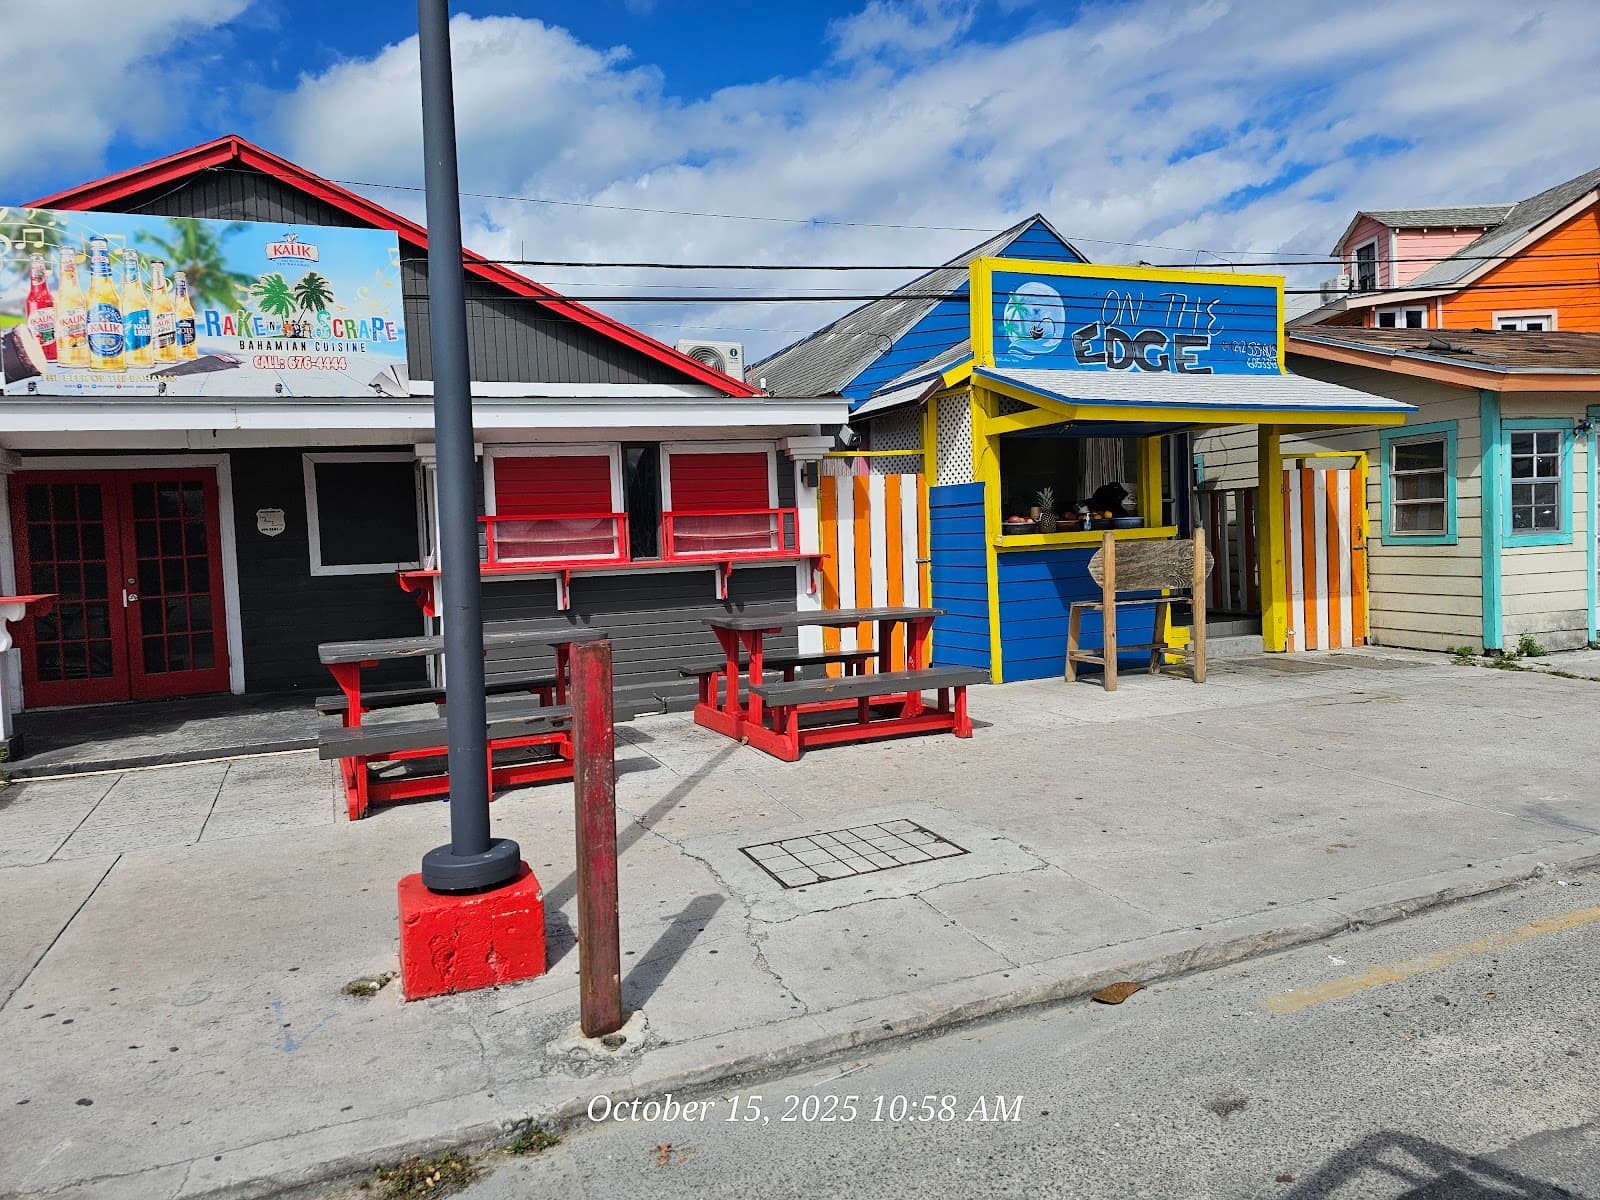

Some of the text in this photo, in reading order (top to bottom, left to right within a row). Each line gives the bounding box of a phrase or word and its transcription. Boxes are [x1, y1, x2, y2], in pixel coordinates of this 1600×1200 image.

[273, 244, 312, 258] KALIK
[1100, 289, 1225, 337] ON THE
[90, 323, 121, 334] KALIK
[204, 309, 266, 339] RAKE
[315, 309, 398, 342] SCRAPE
[239, 339, 367, 353] BAHAMIAN CUISINE
[1071, 320, 1214, 375] EDGE
[253, 354, 348, 370] CALL: 676-4444
